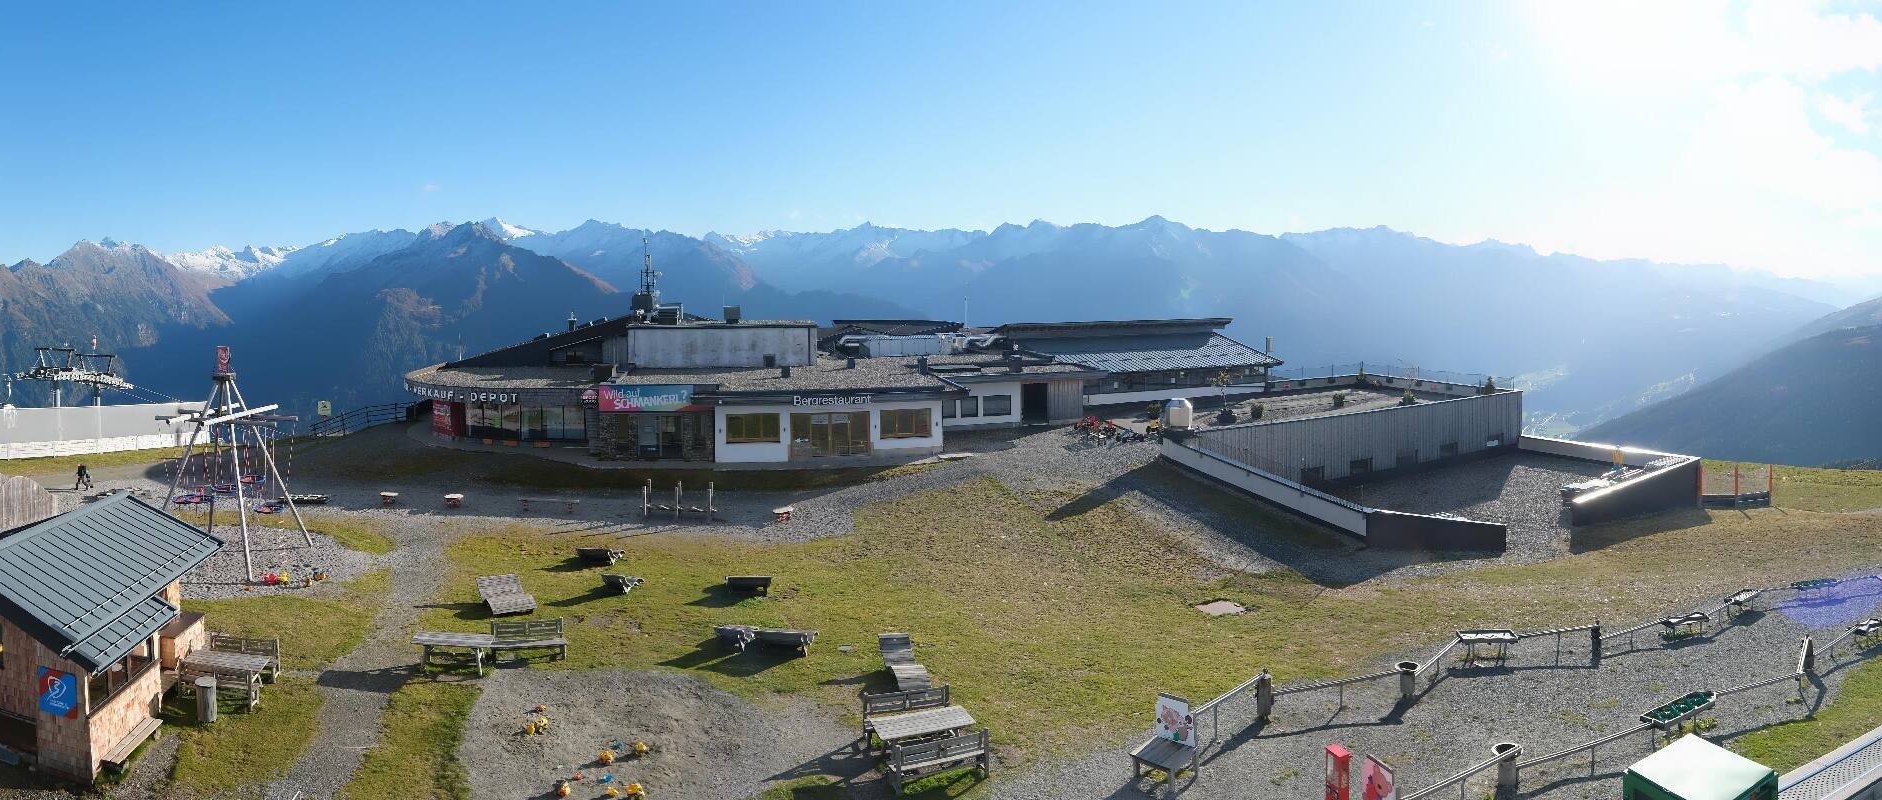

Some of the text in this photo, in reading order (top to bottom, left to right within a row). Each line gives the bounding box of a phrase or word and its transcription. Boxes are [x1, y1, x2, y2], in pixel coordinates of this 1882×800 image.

[413, 386, 454, 400] VERKAUF
[470, 392, 518, 403] DEPOT
[603, 388, 641, 400] Wild auf
[613, 389, 688, 410] SCHMANKERL?
[793, 395, 872, 406] Bergrestaurant
